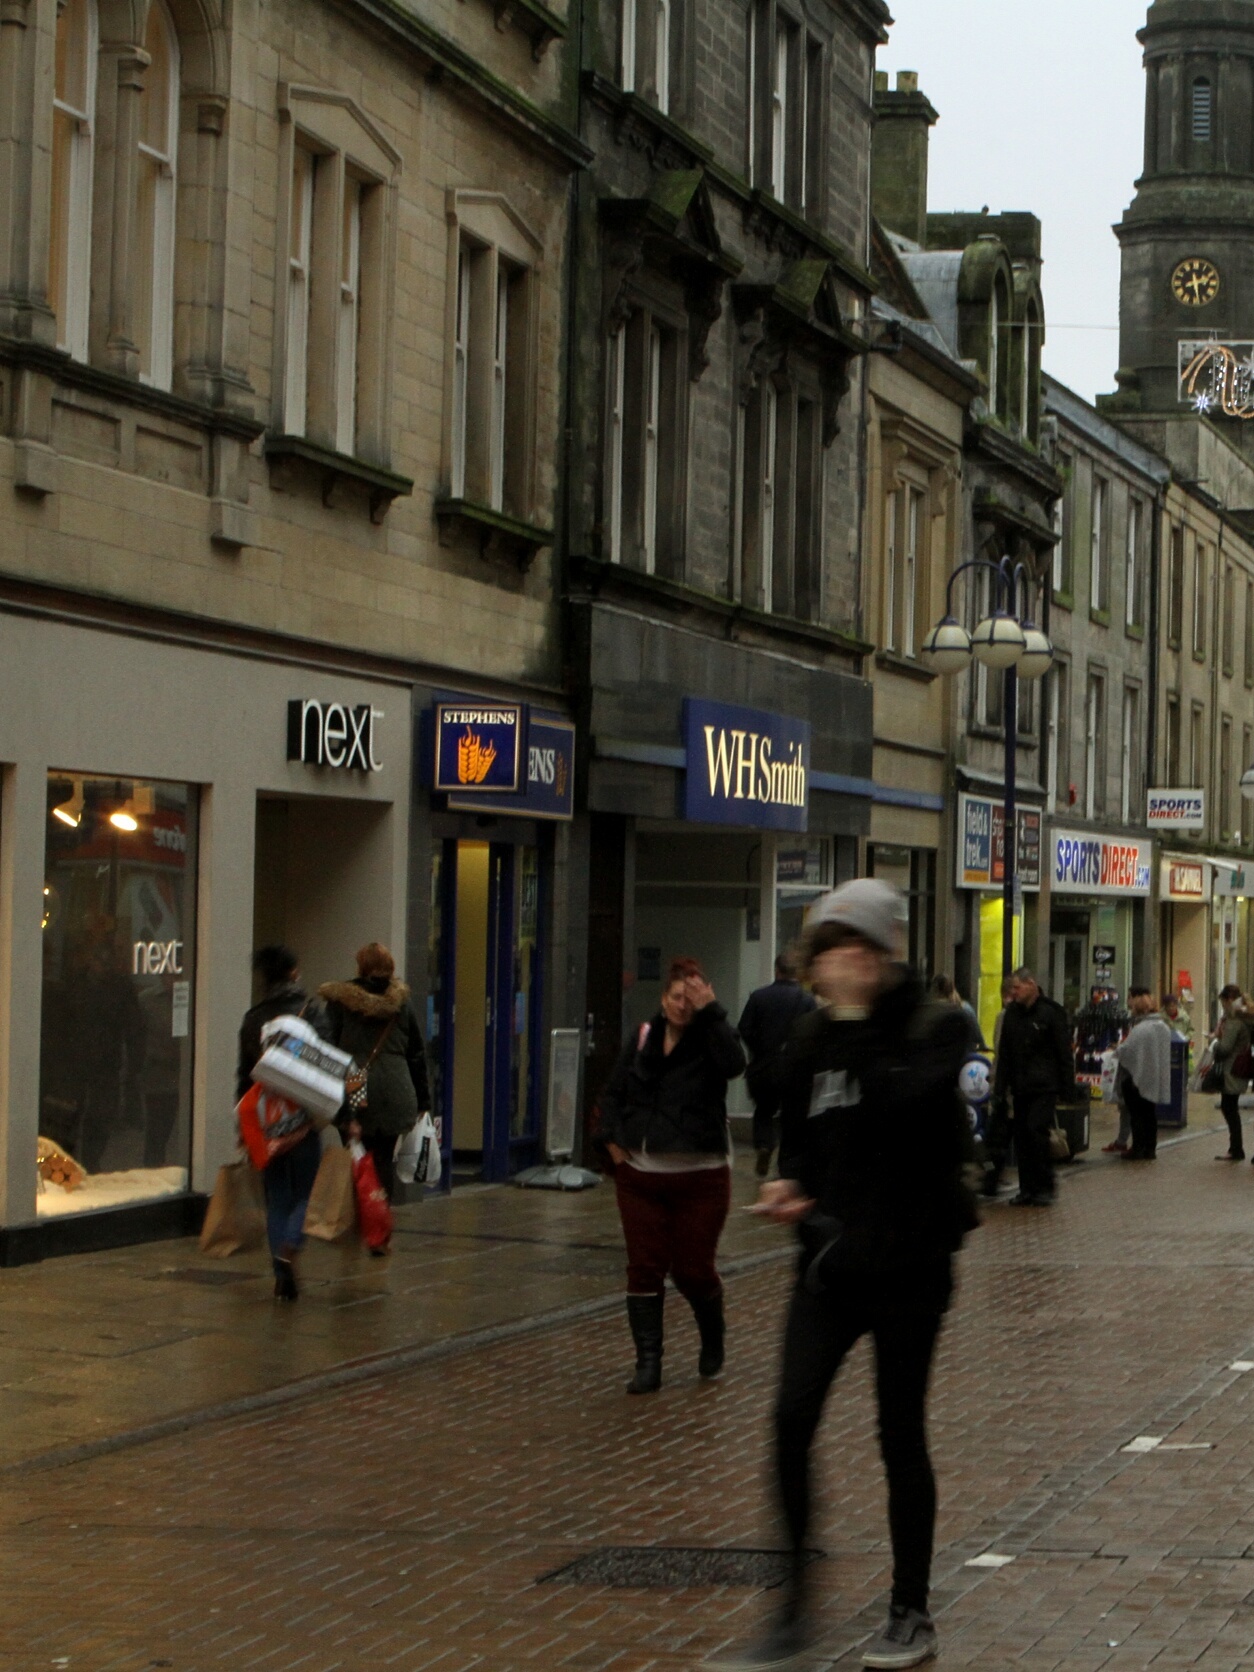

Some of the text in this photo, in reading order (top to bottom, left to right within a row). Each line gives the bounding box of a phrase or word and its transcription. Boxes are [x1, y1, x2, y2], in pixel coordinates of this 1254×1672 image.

[443, 711, 515, 725] STEPHENS
[301, 698, 385, 772] next
[1149, 799, 1202, 811] SPORTS
[133, 940, 183, 975] next
